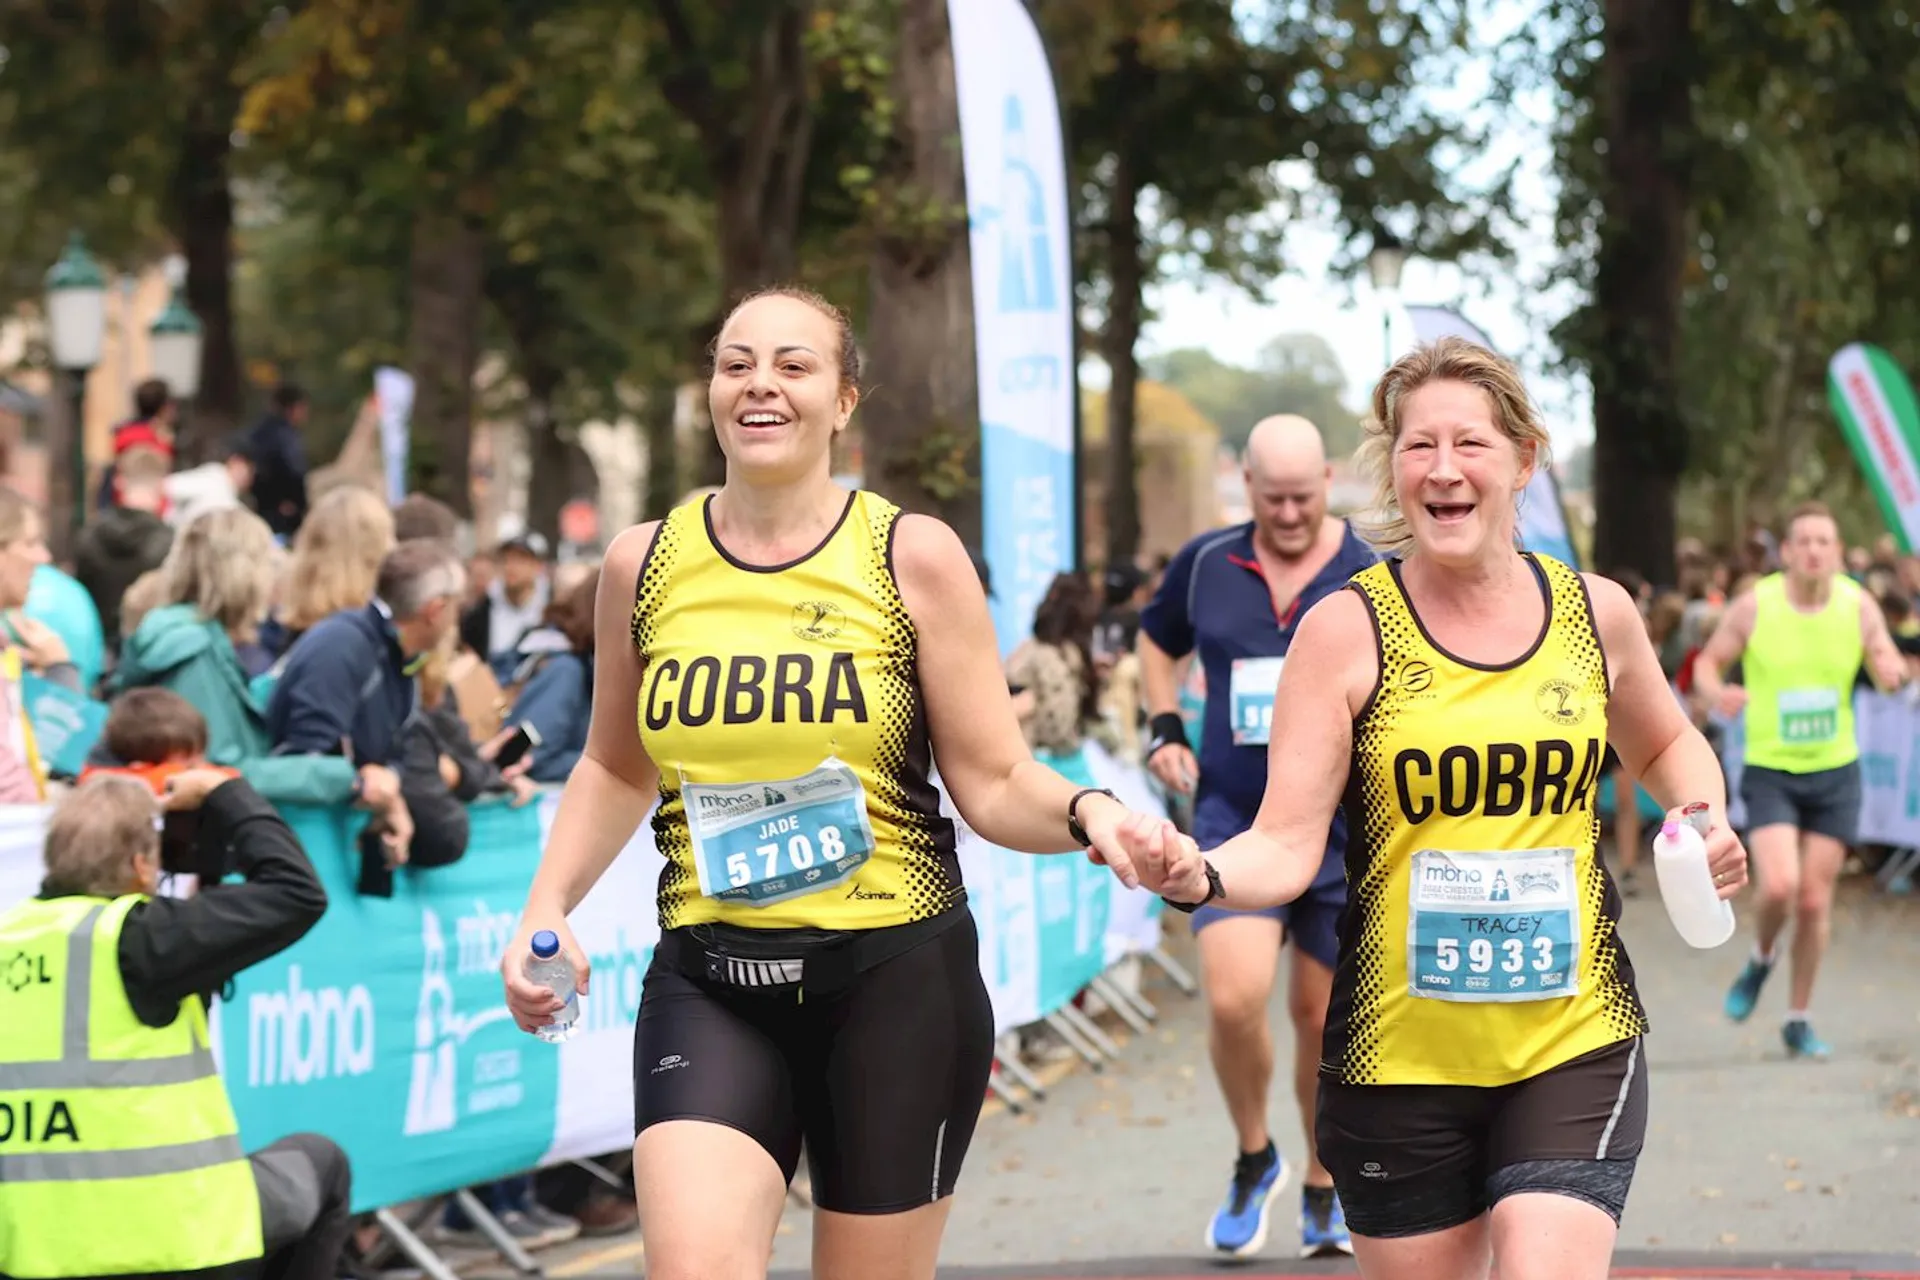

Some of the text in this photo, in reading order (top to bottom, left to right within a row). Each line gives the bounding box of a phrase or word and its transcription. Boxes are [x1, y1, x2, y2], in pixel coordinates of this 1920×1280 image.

[646, 652, 868, 731] COBRA
[1394, 738, 1599, 825] COBRA
[759, 815, 800, 840] JADE
[726, 825, 846, 888] 5708
[1426, 864, 1482, 882] mbna
[855, 891, 897, 901] Scimitar
[1461, 915, 1543, 940] TRACEY
[1436, 936, 1553, 973] 5933
[1422, 974, 1450, 985] mbna
[248, 963, 374, 1087] mbna
